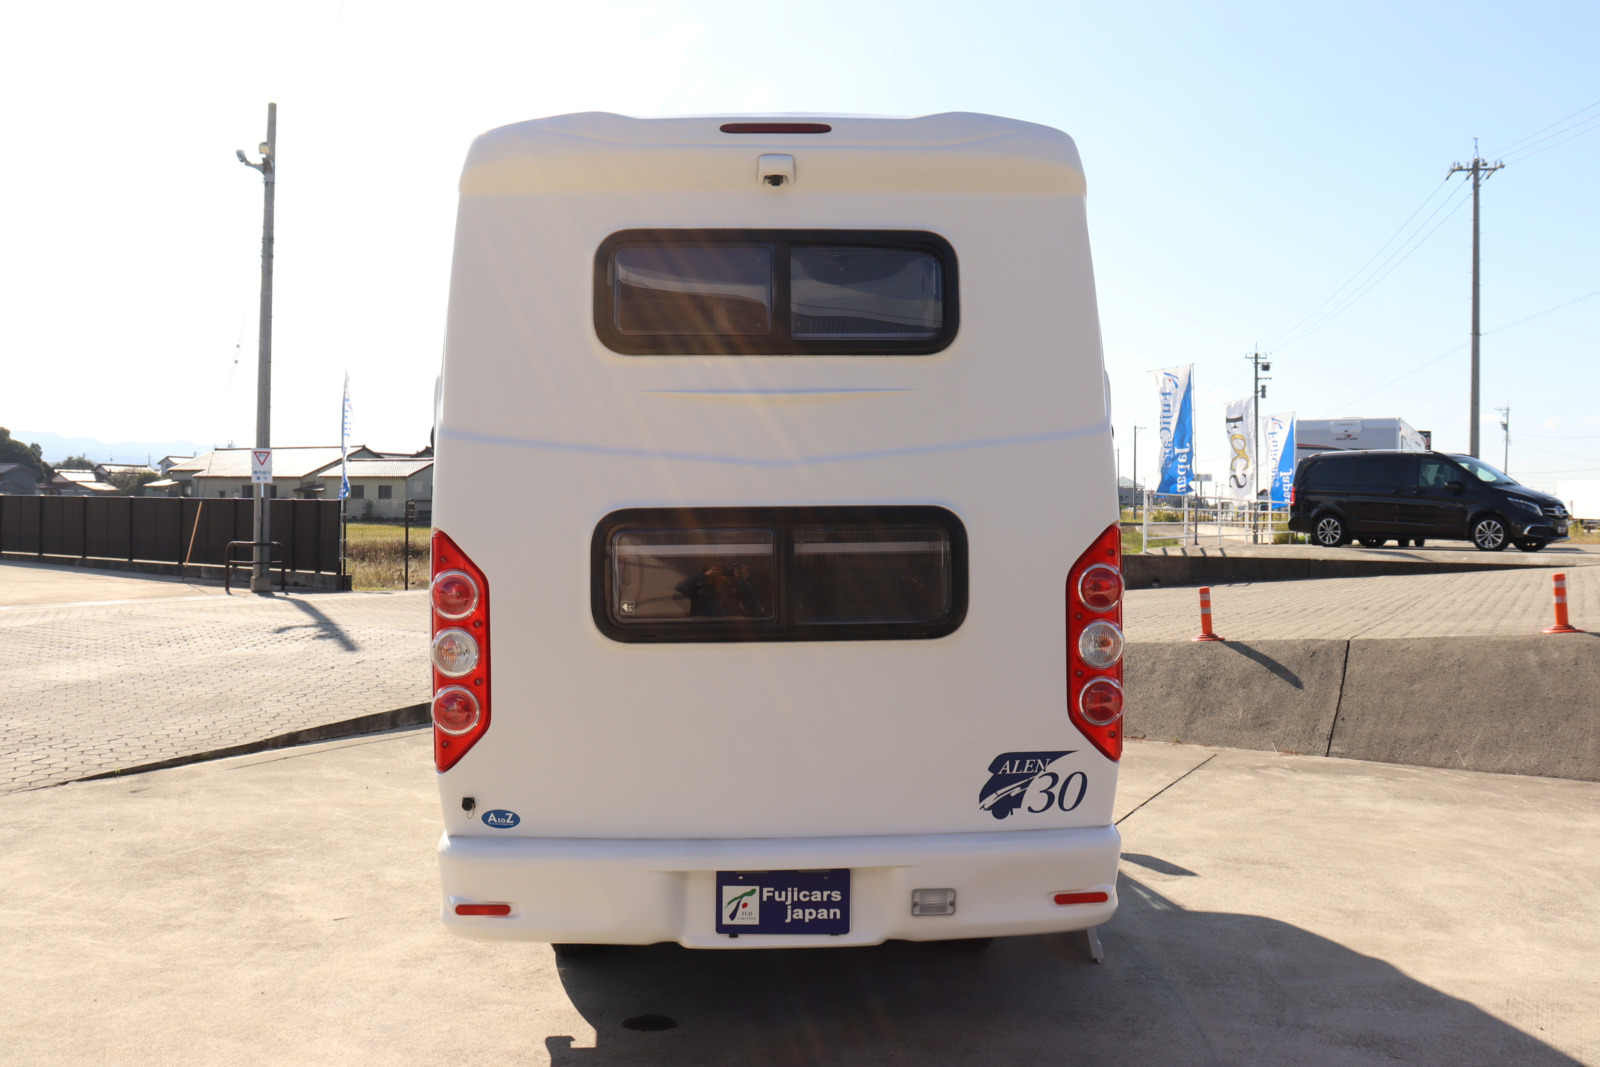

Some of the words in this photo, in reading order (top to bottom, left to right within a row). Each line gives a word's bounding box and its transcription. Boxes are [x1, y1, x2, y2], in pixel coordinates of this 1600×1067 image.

[998, 759, 1051, 775] ALEN
[1027, 771, 1088, 813] 30
[762, 887, 842, 905] Fujicars
[785, 905, 841, 923] japan
